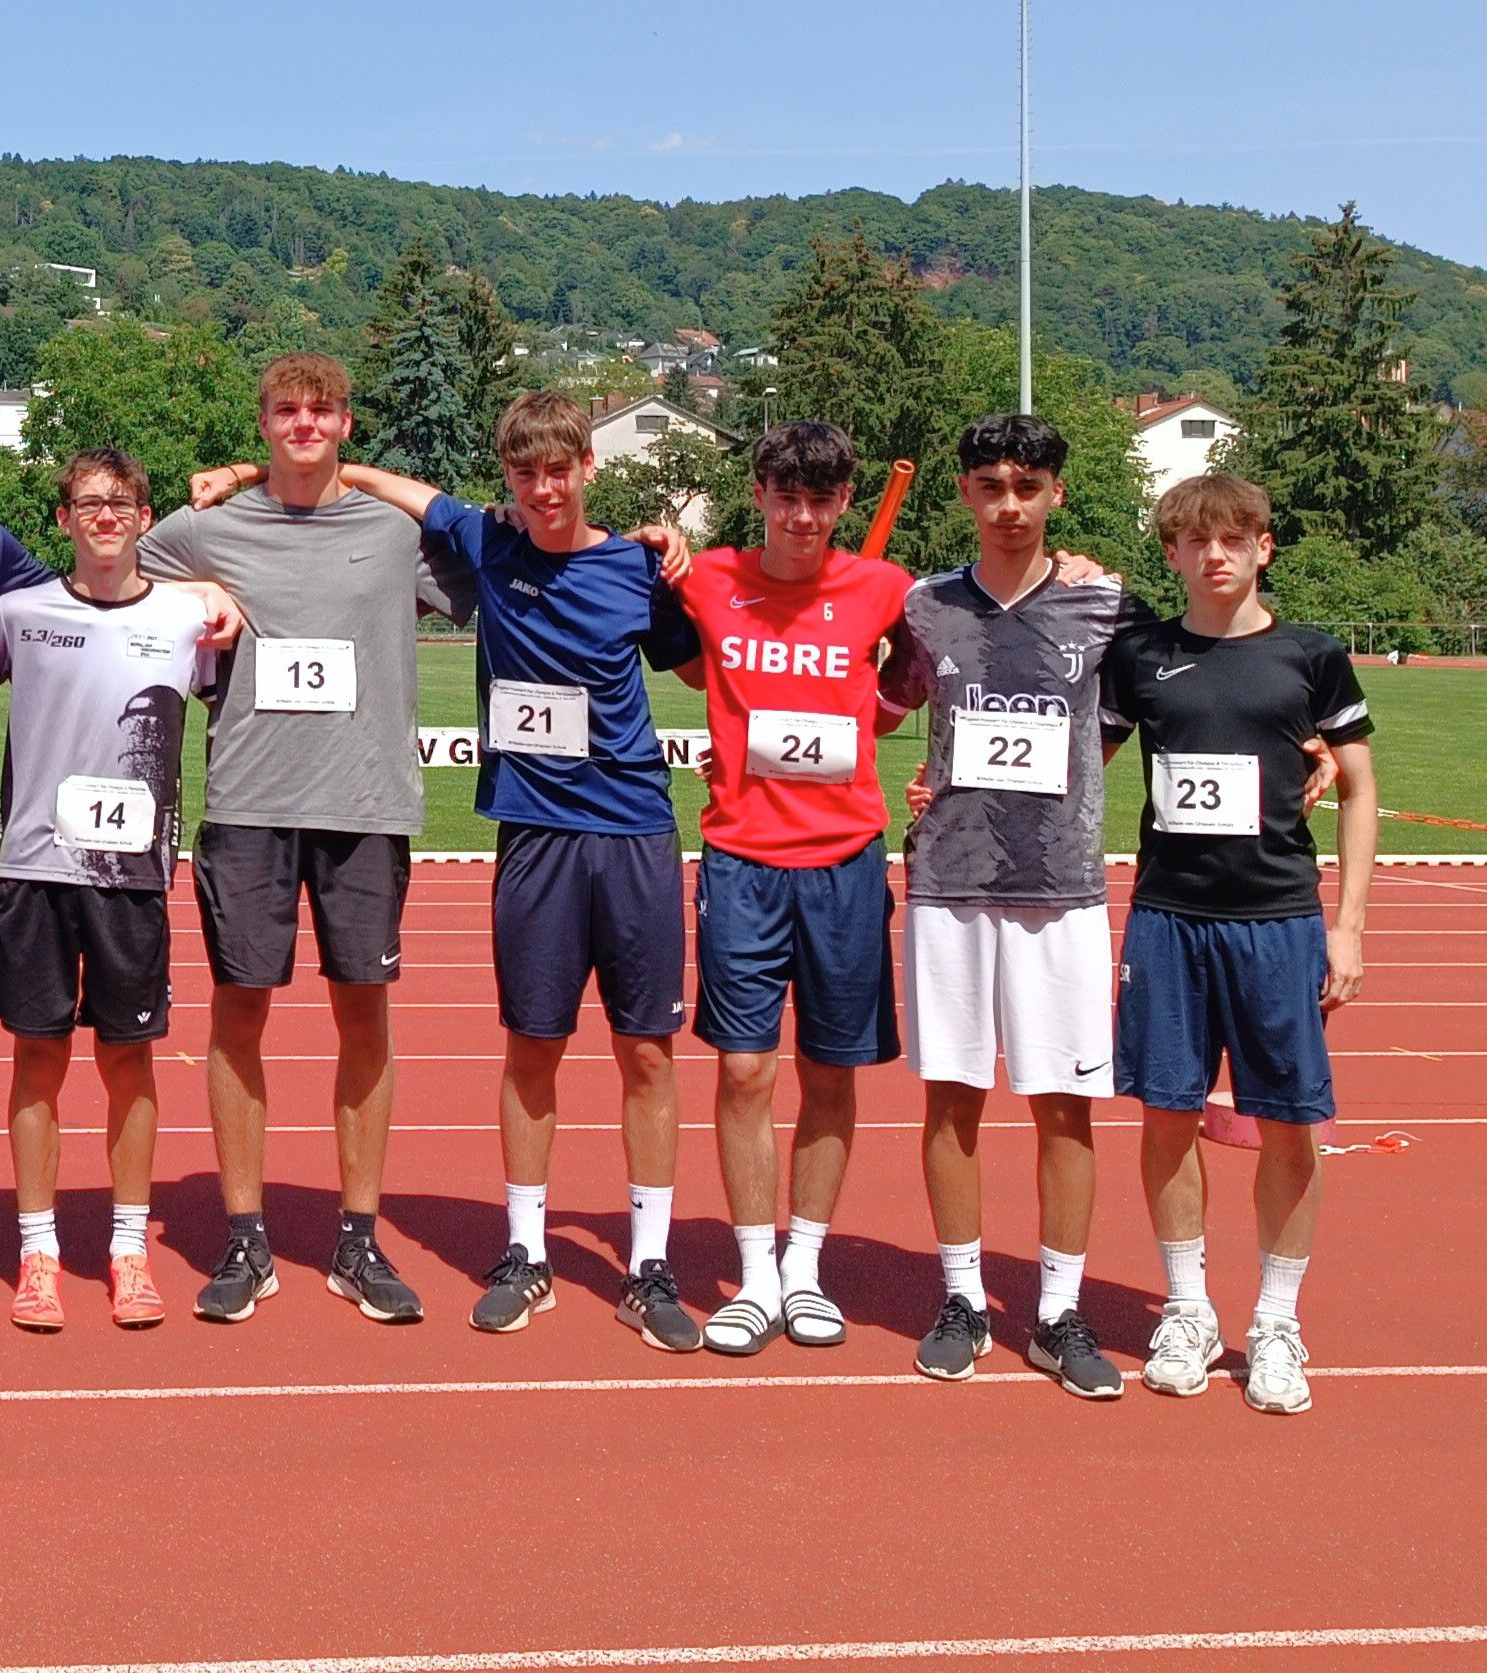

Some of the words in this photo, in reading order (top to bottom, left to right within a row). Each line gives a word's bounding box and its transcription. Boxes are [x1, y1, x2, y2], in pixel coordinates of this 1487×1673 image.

[509, 578, 539, 597] JAKO
[824, 602, 833, 621] 6
[721, 636, 850, 679] SIBRE
[287, 661, 325, 689] 13
[517, 704, 552, 734] 21
[418, 738, 437, 764] V
[449, 738, 481, 764] G
[660, 739, 689, 765] N
[780, 734, 823, 764] 24
[987, 736, 1032, 768] 22
[1177, 779, 1221, 810] 23
[89, 800, 125, 829] 14
